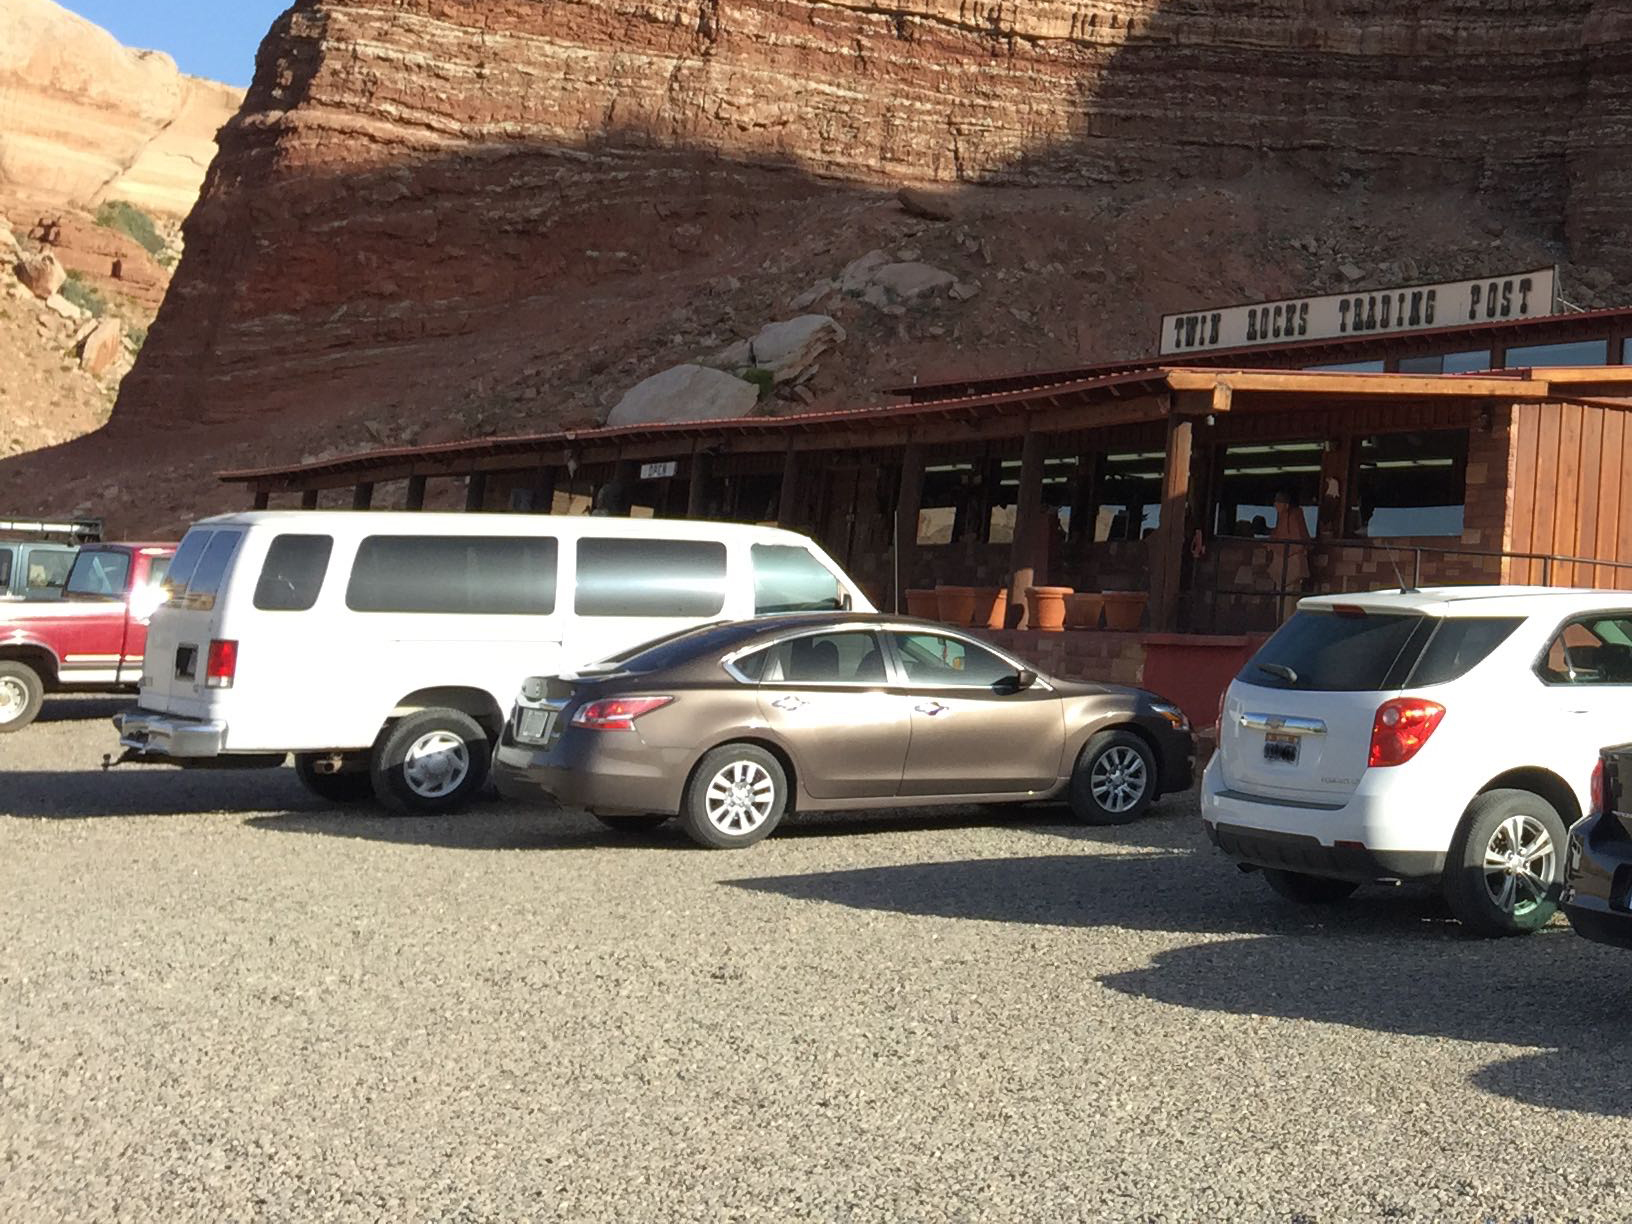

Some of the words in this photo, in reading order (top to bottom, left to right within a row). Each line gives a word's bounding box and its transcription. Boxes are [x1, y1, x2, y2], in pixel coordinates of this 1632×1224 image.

[1174, 313, 1222, 348] TWIN
[1246, 302, 1309, 341] ROCKS
[1338, 289, 1437, 332] TRADING
[1469, 278, 1533, 321] POST
